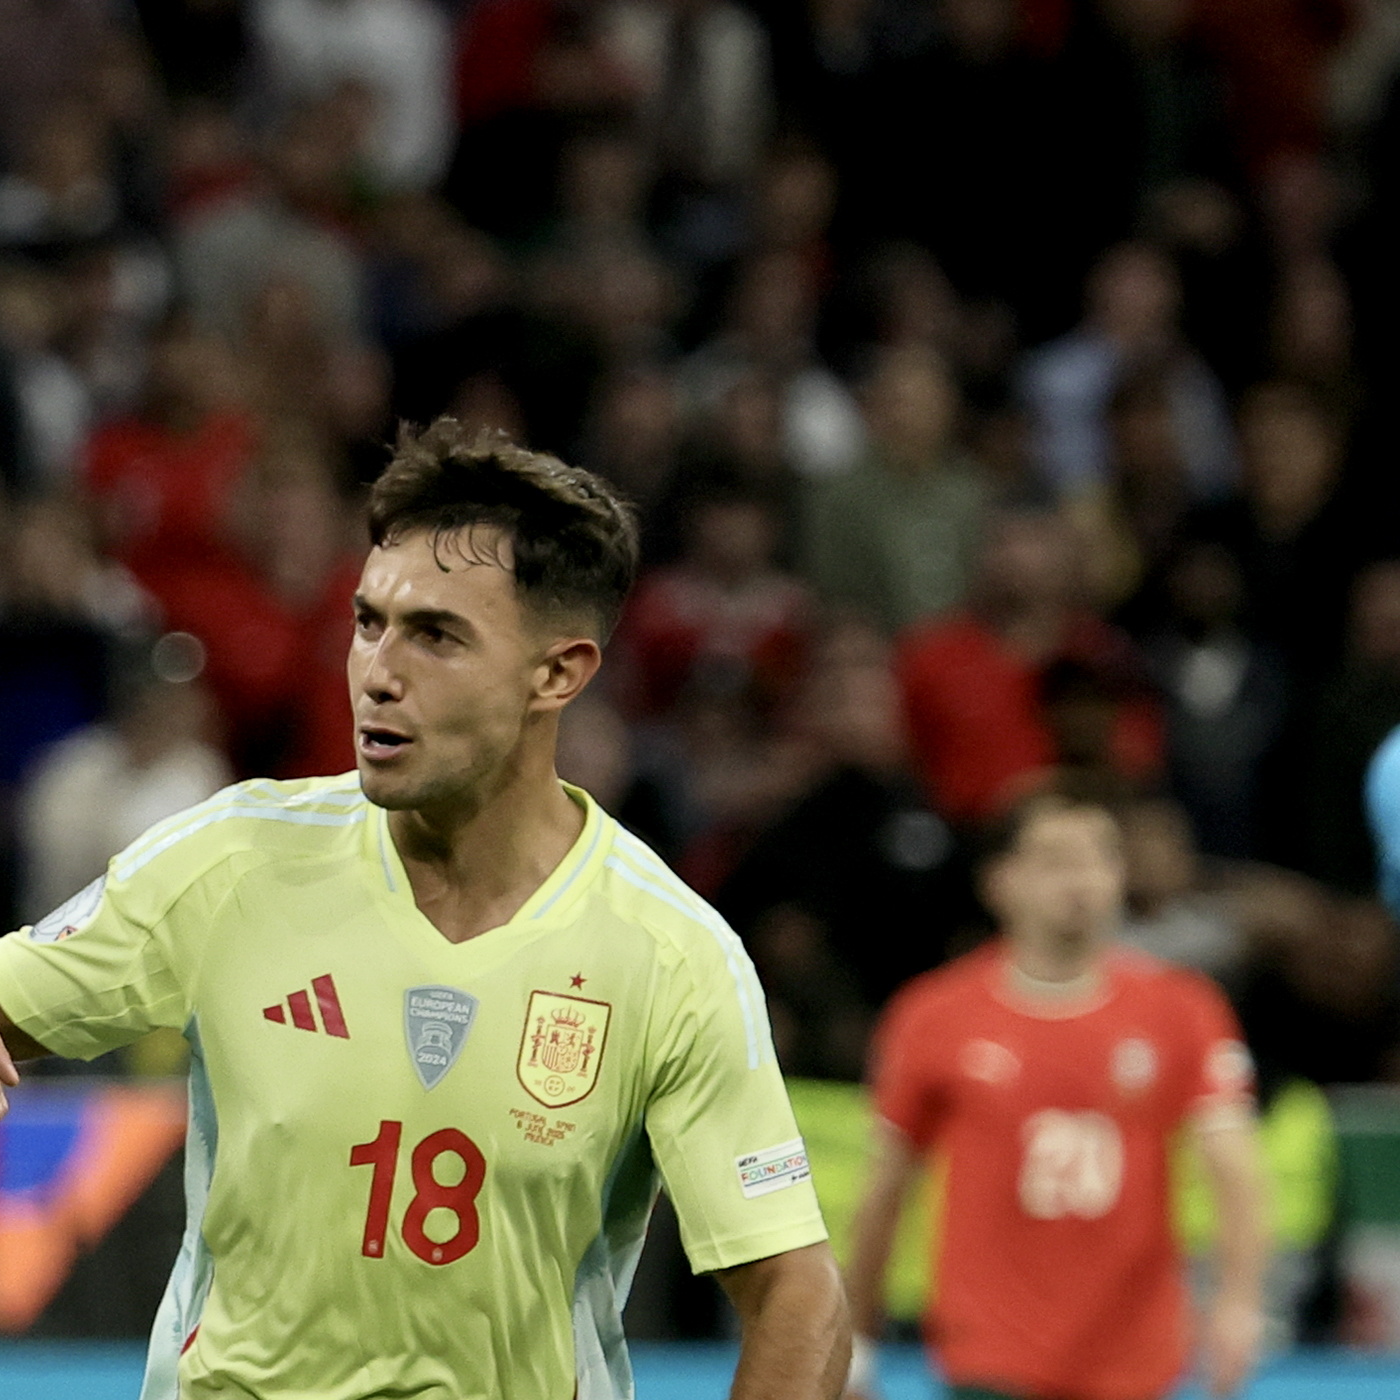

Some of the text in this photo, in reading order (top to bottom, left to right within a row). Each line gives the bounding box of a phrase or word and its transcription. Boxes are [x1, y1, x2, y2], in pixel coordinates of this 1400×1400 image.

[410, 996, 469, 1015] EUROPEAN
[409, 1007, 469, 1024] CHAMPIONS
[417, 1052, 447, 1066] 2024
[349, 1119, 486, 1267] 18
